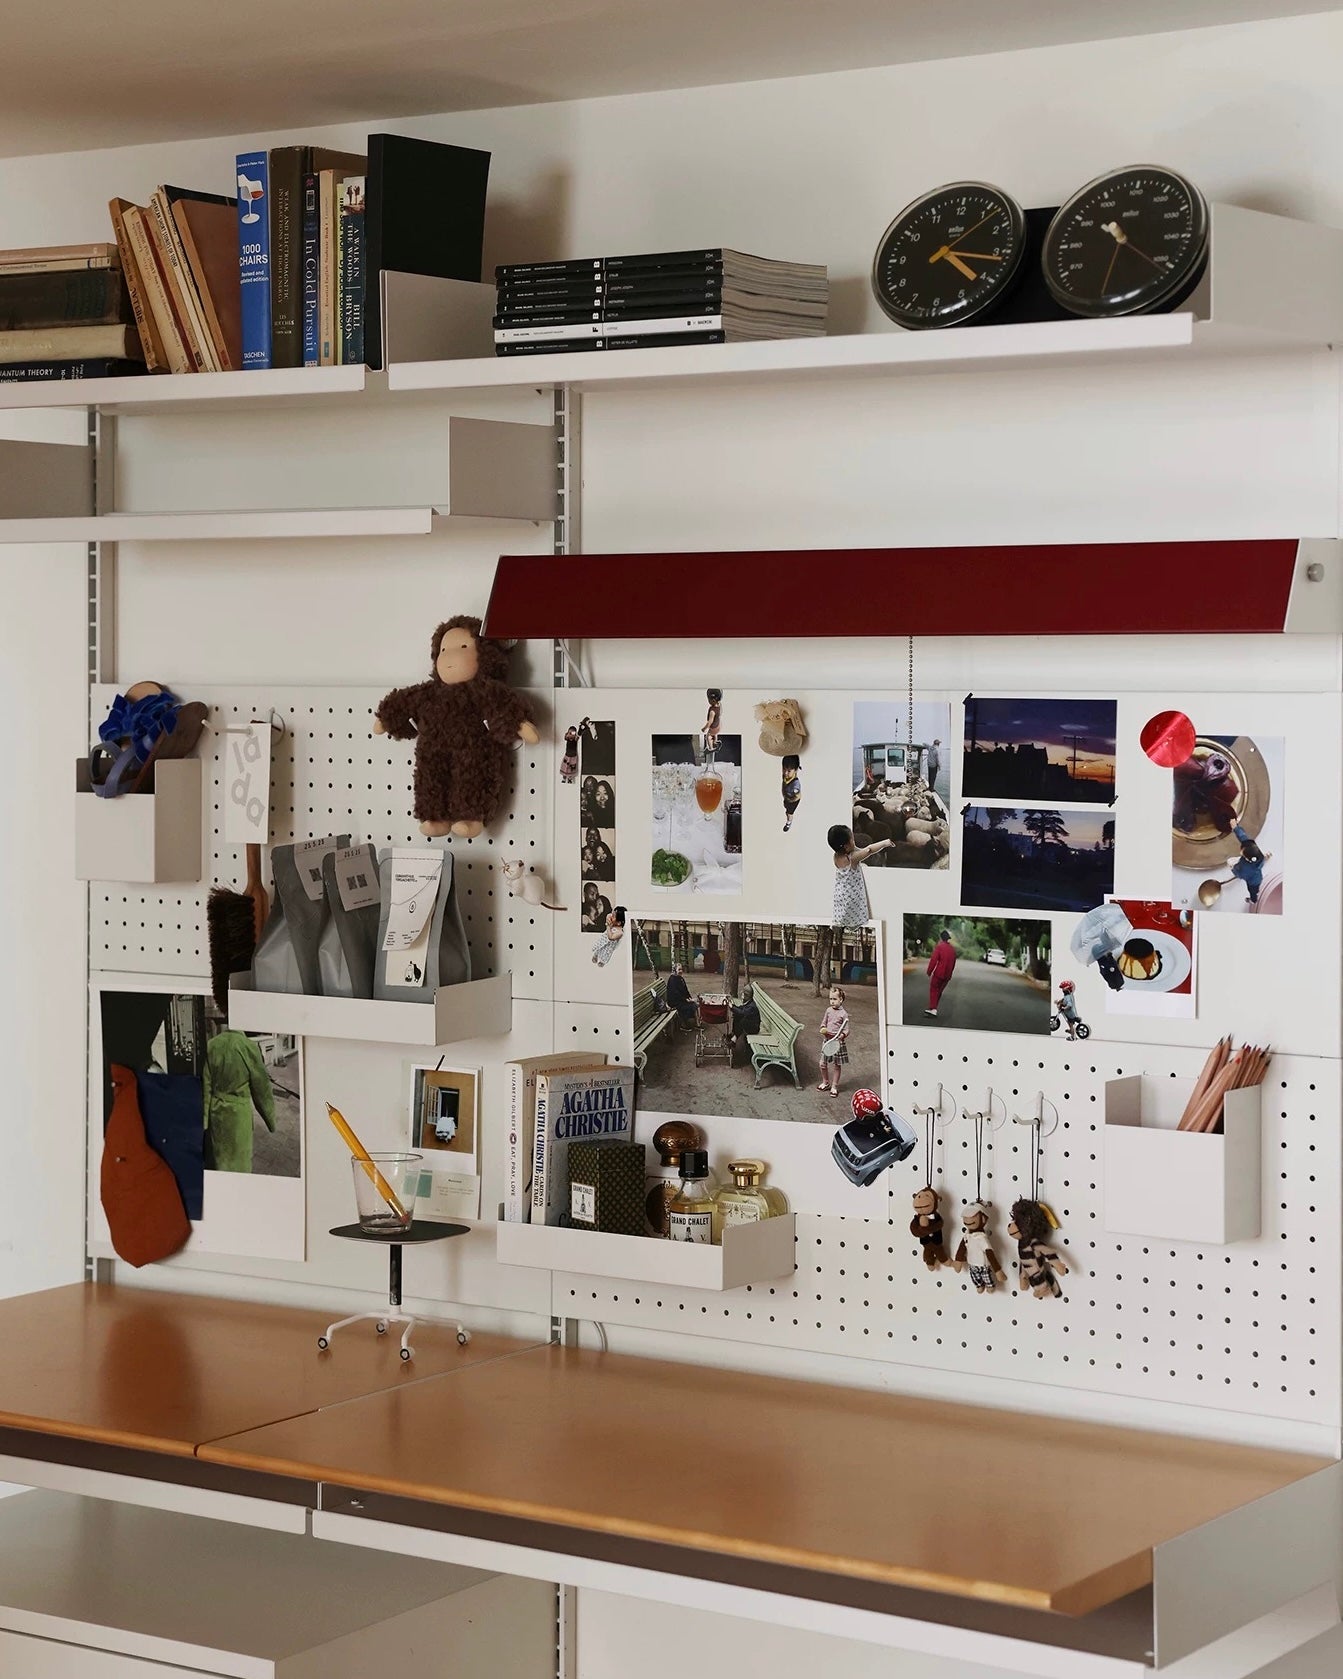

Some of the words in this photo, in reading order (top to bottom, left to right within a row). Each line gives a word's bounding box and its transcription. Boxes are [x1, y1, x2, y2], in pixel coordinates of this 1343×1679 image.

[956, 206, 966, 215] 12
[992, 226, 999, 235] 2
[910, 234, 921, 242] 10
[242, 244, 261, 254] 1000
[305, 239, 316, 254] In
[992, 248, 1000, 256] 3
[240, 254, 268, 266] CHAIRS
[900, 256, 906, 264] 9
[304, 257, 317, 293] Cold
[354, 267, 359, 277] IN
[899, 278, 906, 287] 8
[912, 293, 918, 302] 7
[958, 289, 965, 298] 5
[933, 298, 940, 306] 6
[304, 299, 317, 352] Pursuit
[0, 369, 25, 377] ANTUM
[28, 368, 53, 376] THEORY
[594, 1079, 620, 1087] BESTSELLER
[560, 1087, 625, 1115] AGATHA
[536, 1097, 546, 1133] AGATHA
[555, 1109, 628, 1138] CHRISTIE
[535, 1134, 545, 1174] CHRISTIE
[672, 1216, 686, 1225] GRAND
[688, 1217, 709, 1226] CHALET
